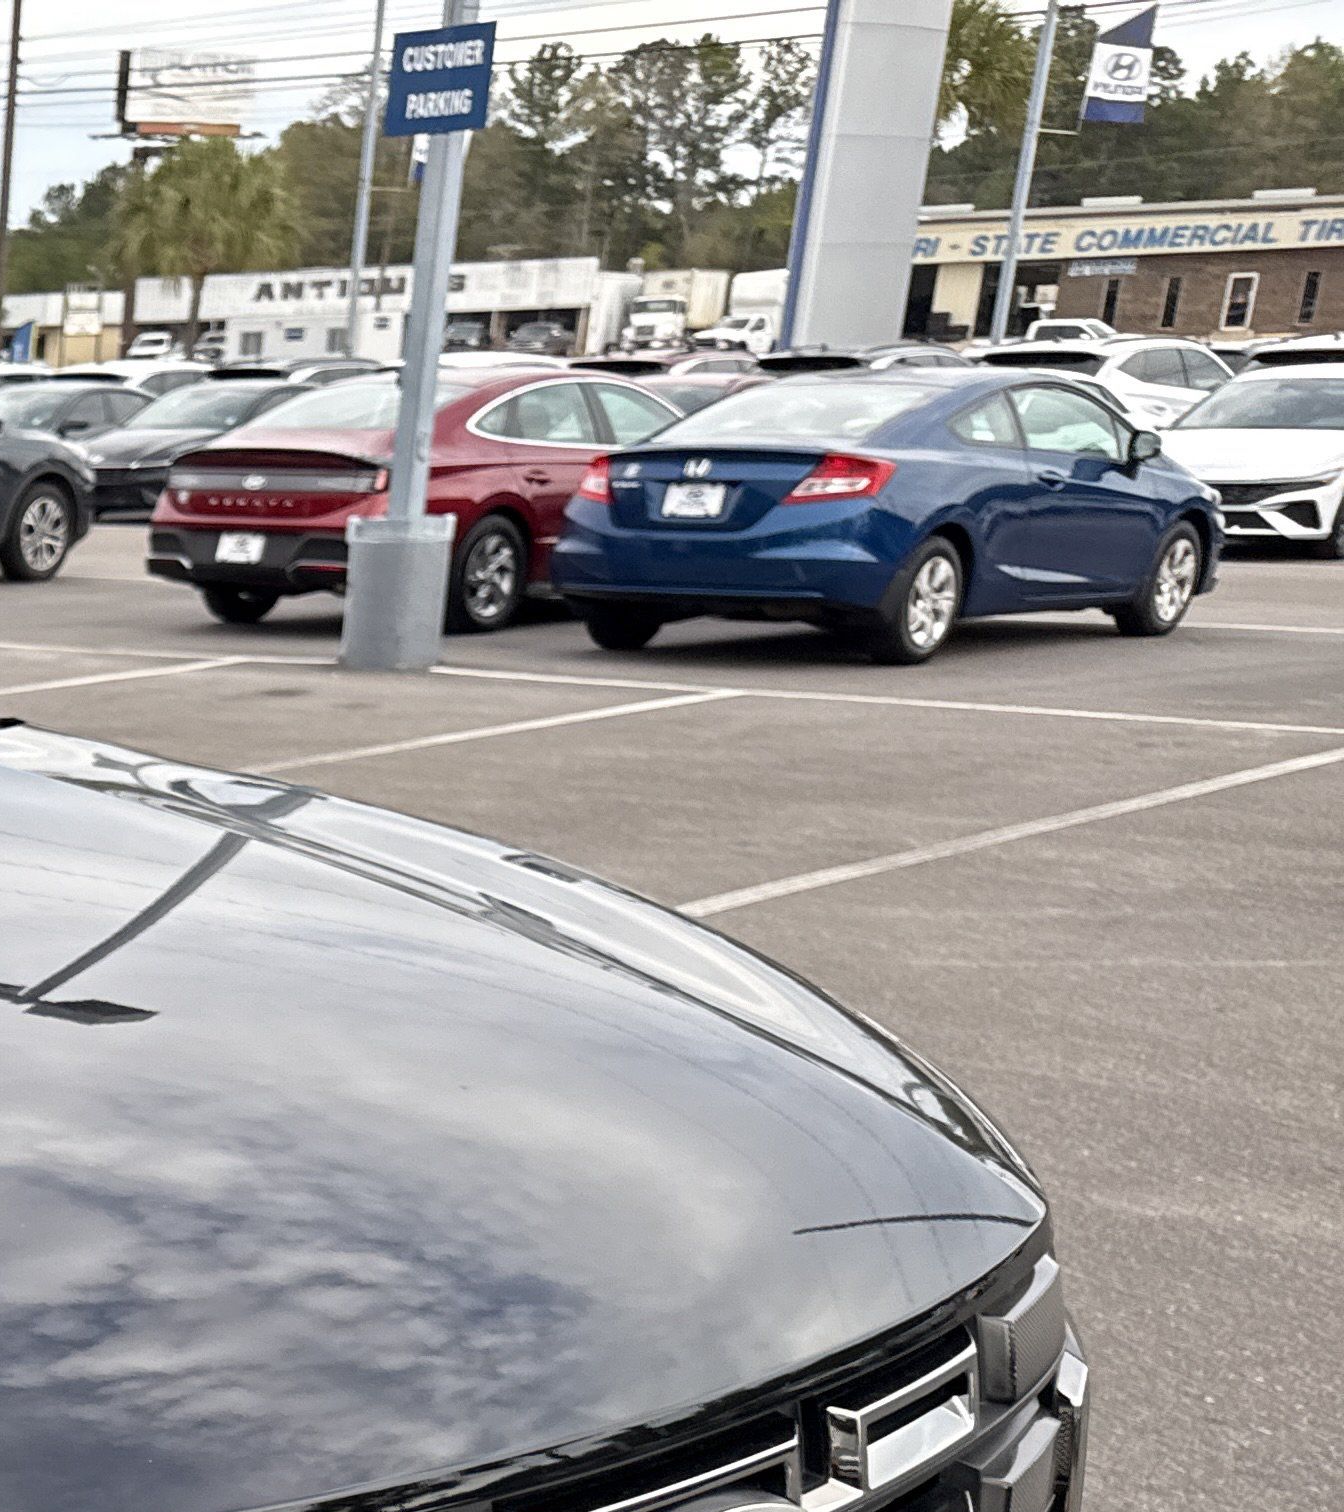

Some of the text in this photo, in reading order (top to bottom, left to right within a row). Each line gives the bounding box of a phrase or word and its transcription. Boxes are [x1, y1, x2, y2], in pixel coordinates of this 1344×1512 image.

[402, 39, 485, 72] CUSTOMER
[405, 88, 473, 119] PARKING
[912, 237, 942, 258] RI
[1074, 222, 1279, 252] COMMERCIAL
[1298, 218, 1344, 242] TIR
[253, 274, 466, 301] ANTIQUS
